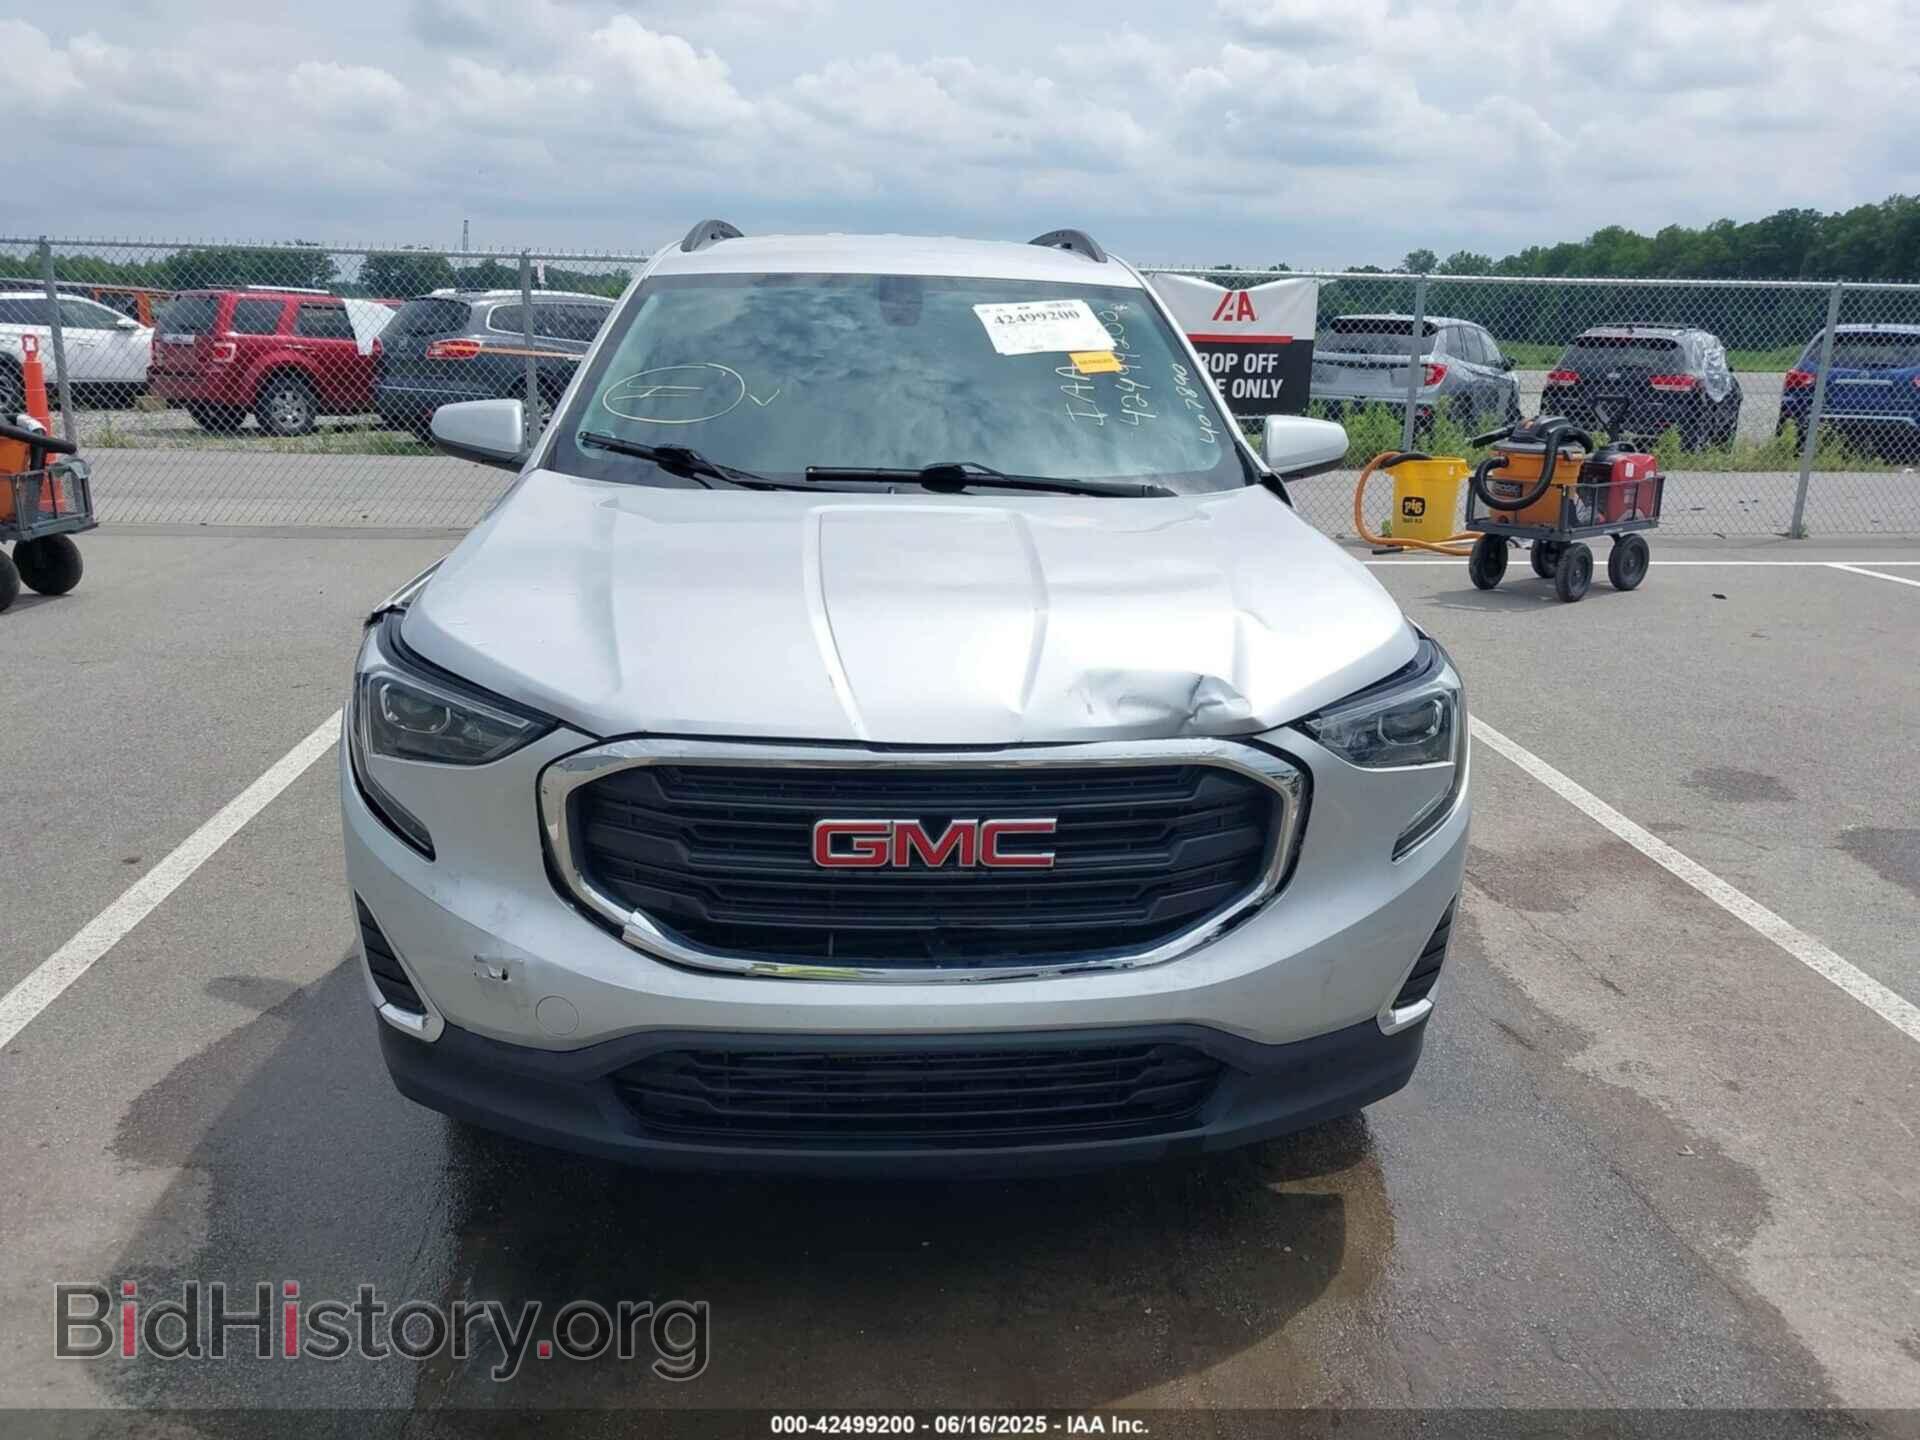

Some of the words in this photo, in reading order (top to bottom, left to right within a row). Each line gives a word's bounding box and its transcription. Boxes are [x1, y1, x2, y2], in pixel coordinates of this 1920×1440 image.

[994, 310, 1081, 325] 42499200
[1198, 352, 1239, 373] ROP
[1243, 353, 1279, 373] OFF
[1231, 378, 1283, 399] ONLY
[813, 819, 1057, 868] GMC
